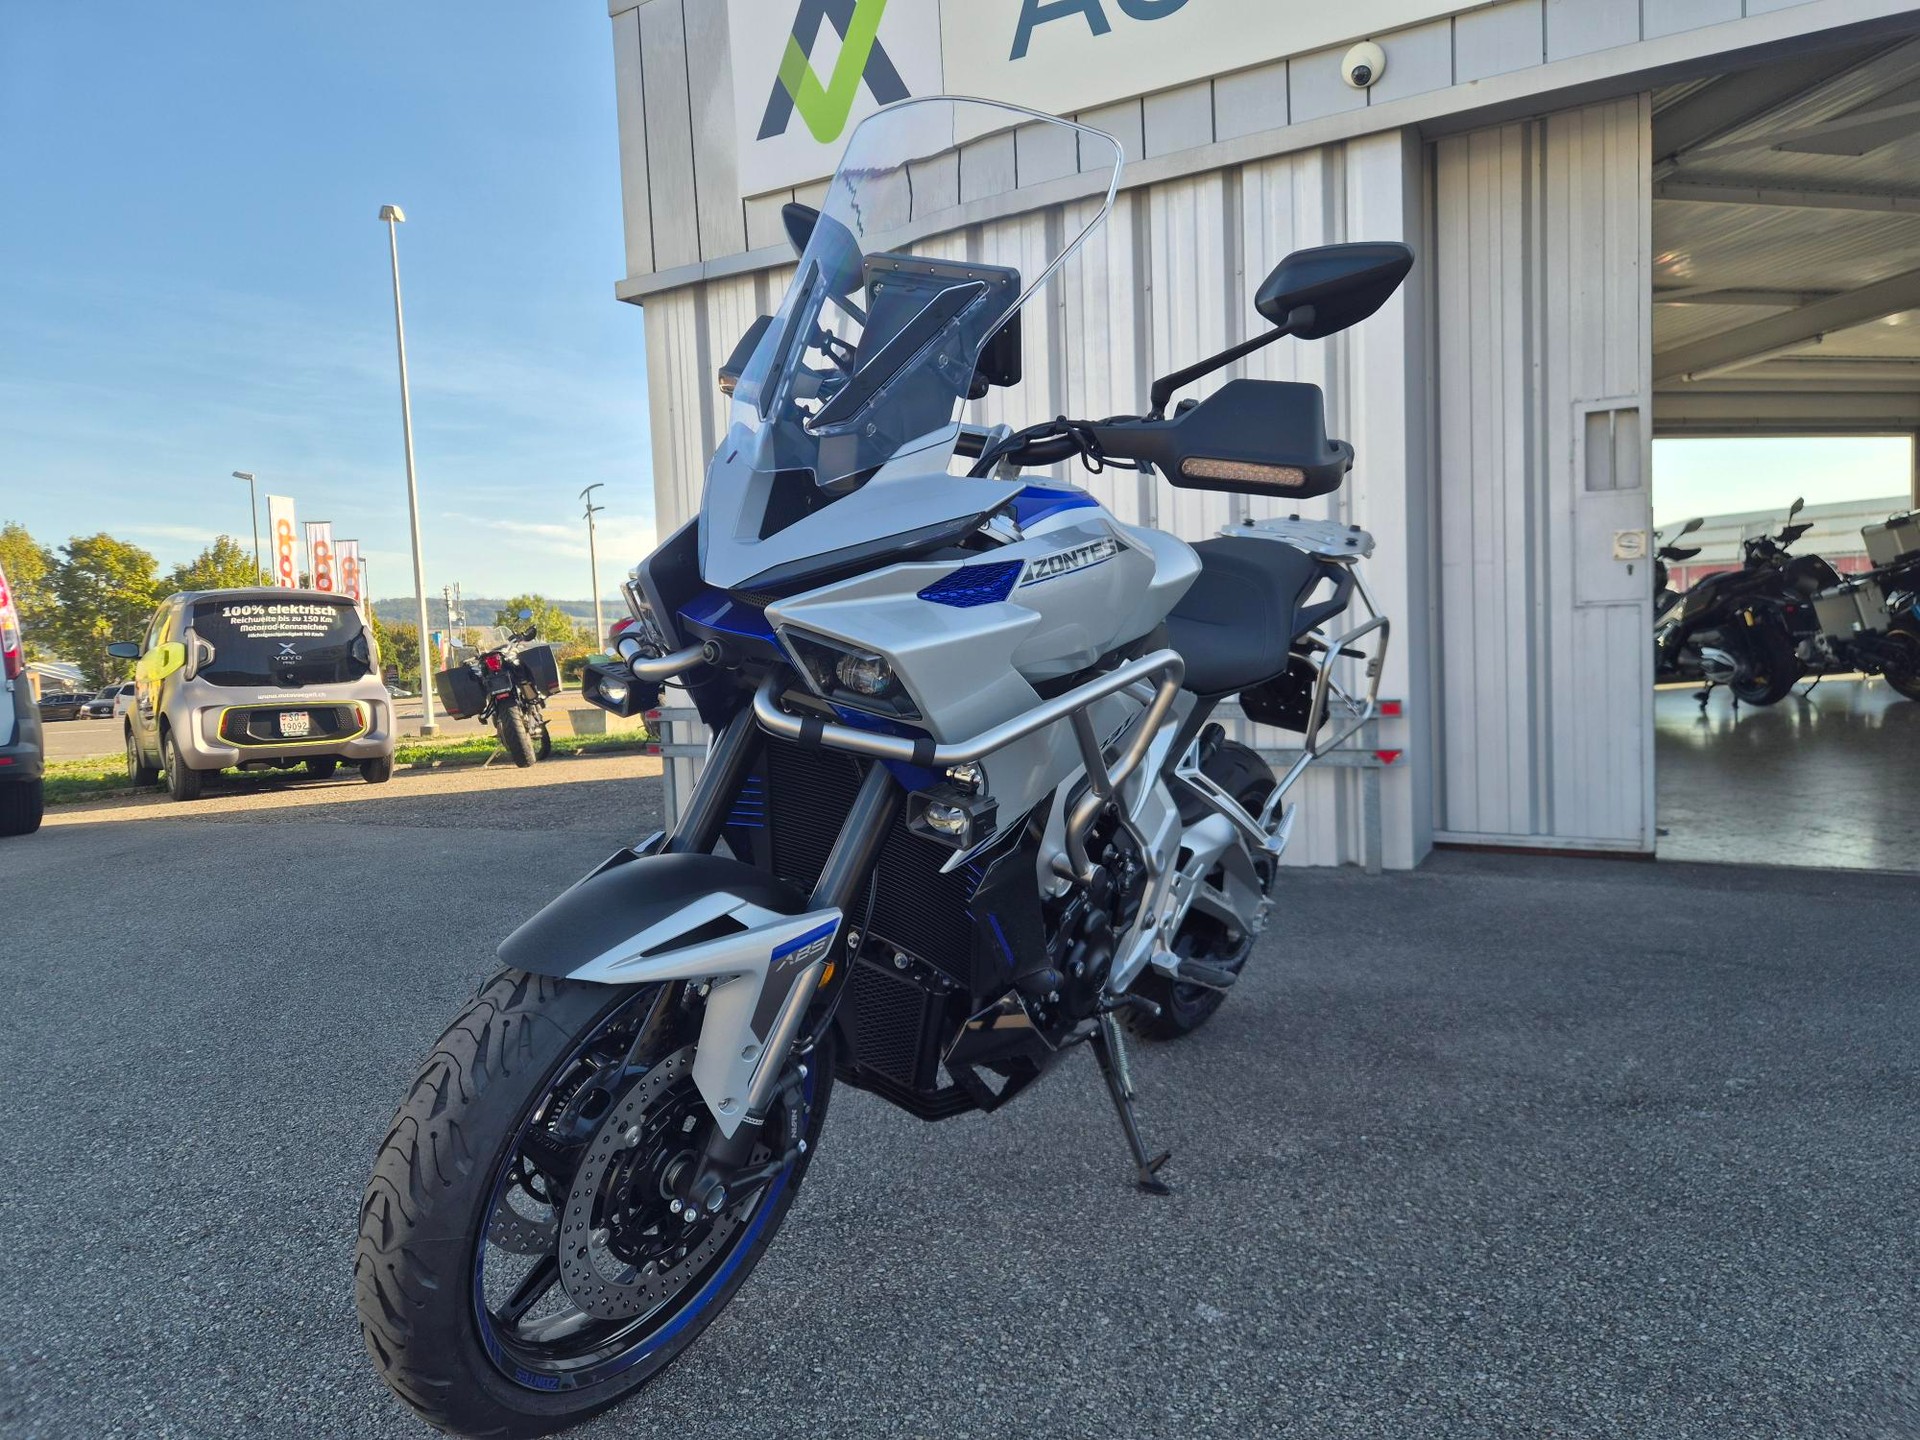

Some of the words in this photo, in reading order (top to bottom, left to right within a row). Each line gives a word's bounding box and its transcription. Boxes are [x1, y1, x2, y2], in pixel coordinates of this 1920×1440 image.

[1032, 538, 1118, 579] ZONTES
[222, 605, 265, 617] 100%
[268, 604, 337, 616] elektrisch
[230, 616, 277, 624] Reichweite
[303, 615, 318, 623] 150
[240, 623, 328, 632] Motorrad-Kennzeichen
[288, 712, 300, 721] SO
[282, 722, 308, 732] 19092
[776, 936, 828, 972] ABS
